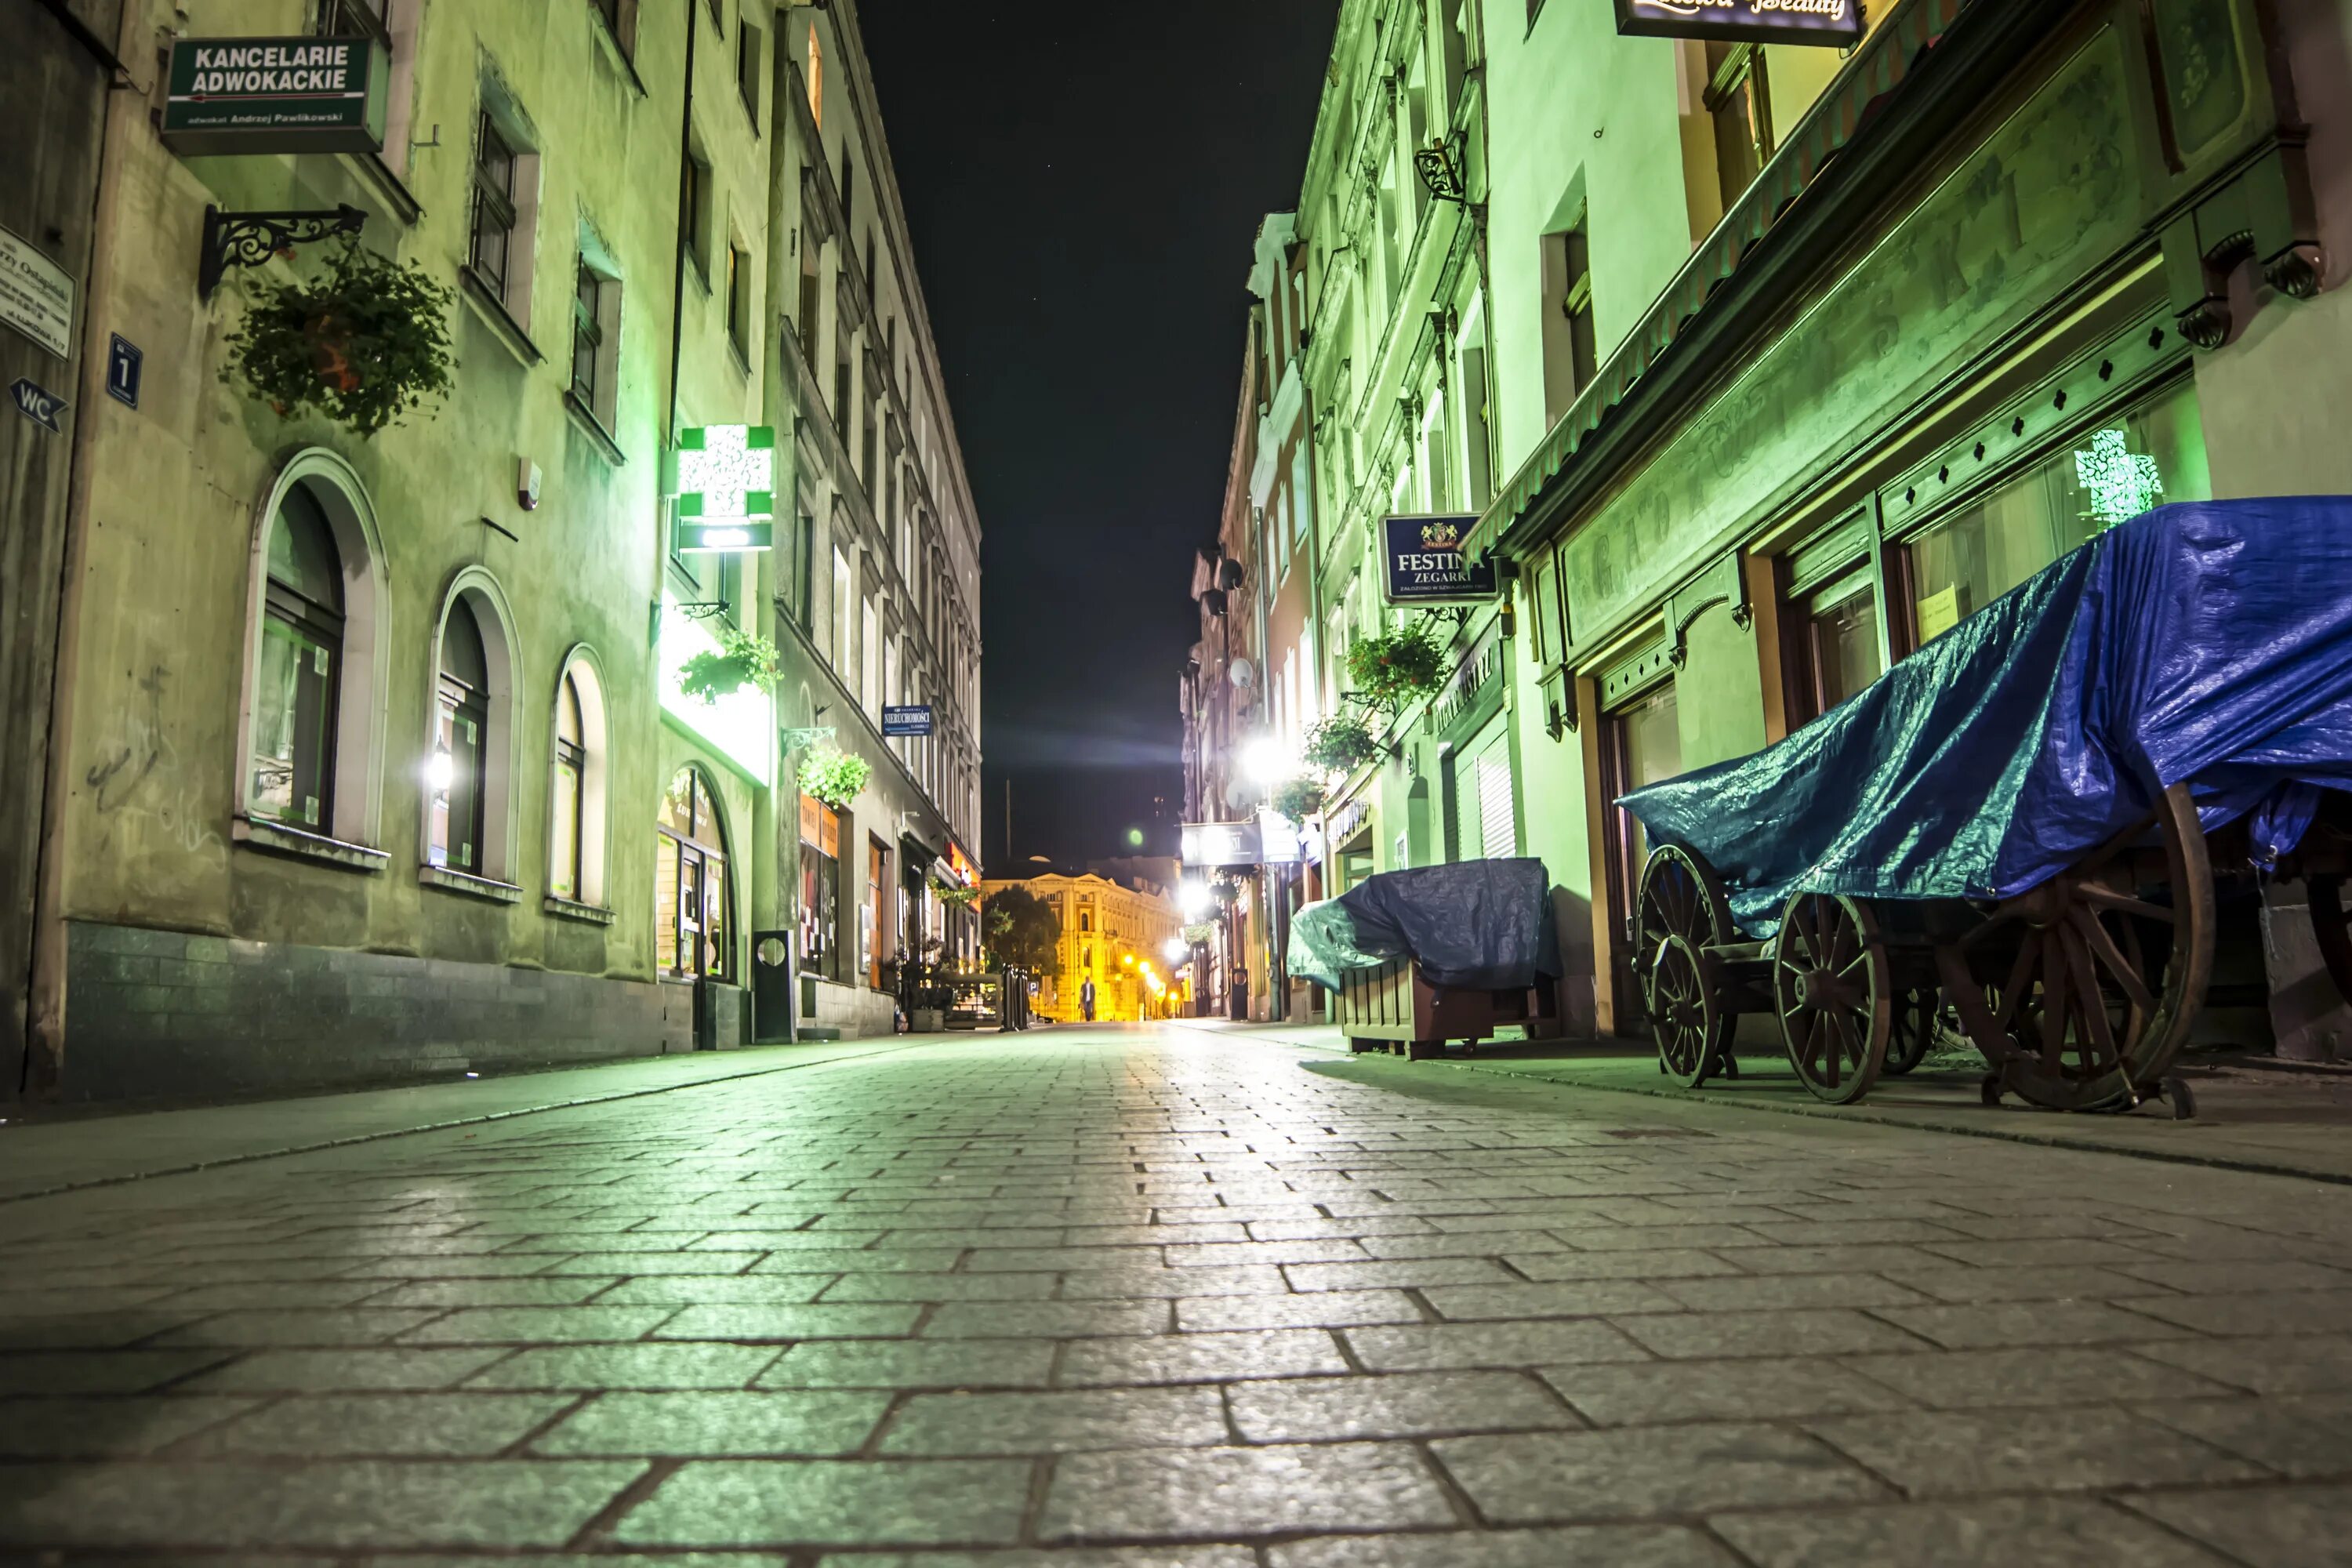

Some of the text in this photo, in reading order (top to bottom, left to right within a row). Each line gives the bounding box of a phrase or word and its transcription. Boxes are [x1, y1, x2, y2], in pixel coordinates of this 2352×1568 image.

[195, 45, 349, 68] KANCELARIE
[191, 69, 347, 92] ADWOKACKIE
[230, 114, 272, 125] Andrzej
[274, 112, 343, 122] Pawlikowski
[119, 358, 129, 387] 1
[20, 383, 51, 421] WC
[1414, 572, 1472, 583] ZEGARKI
[884, 710, 930, 724] NIERUCHOMOŚCI
[1030, 982, 1036, 991] P
